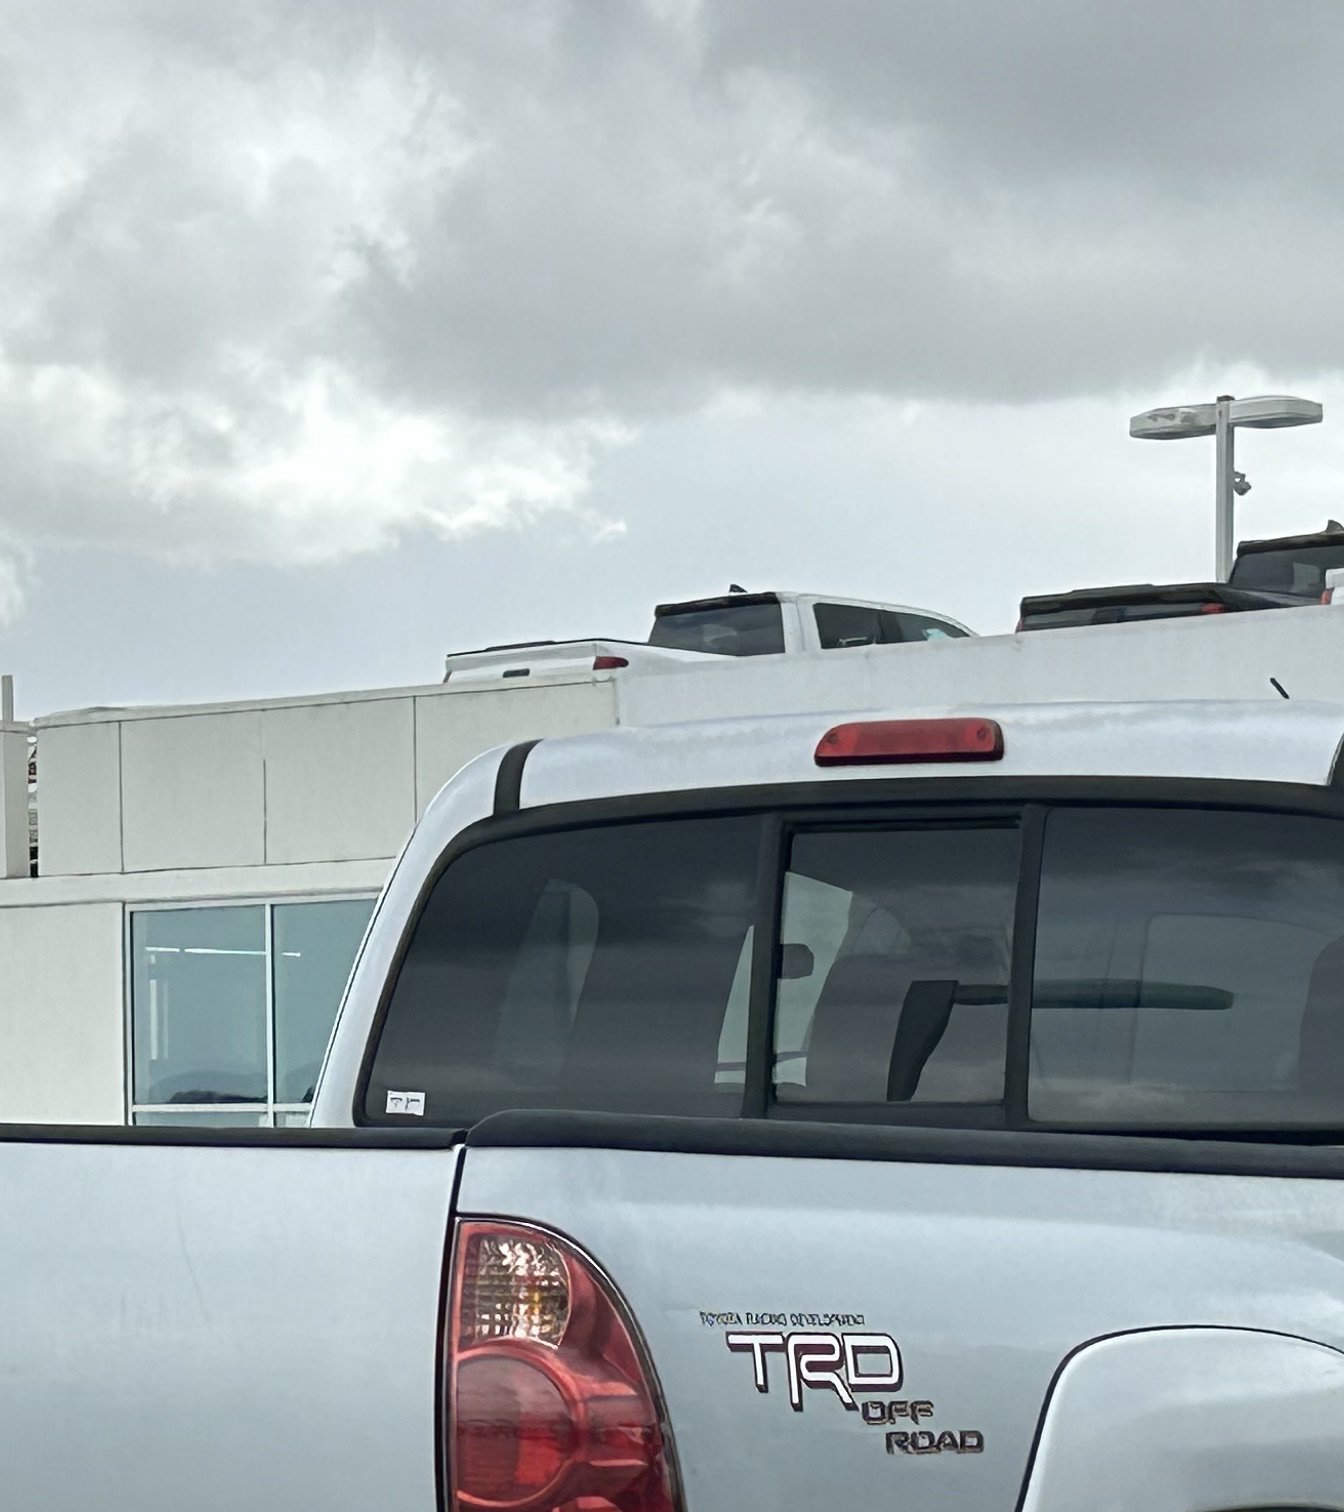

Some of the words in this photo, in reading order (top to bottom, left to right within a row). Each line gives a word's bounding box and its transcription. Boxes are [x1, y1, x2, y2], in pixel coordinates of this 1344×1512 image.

[725, 1331, 904, 1412] TRD
[861, 1400, 934, 1425] OFF
[885, 1430, 984, 1454] ROAD
